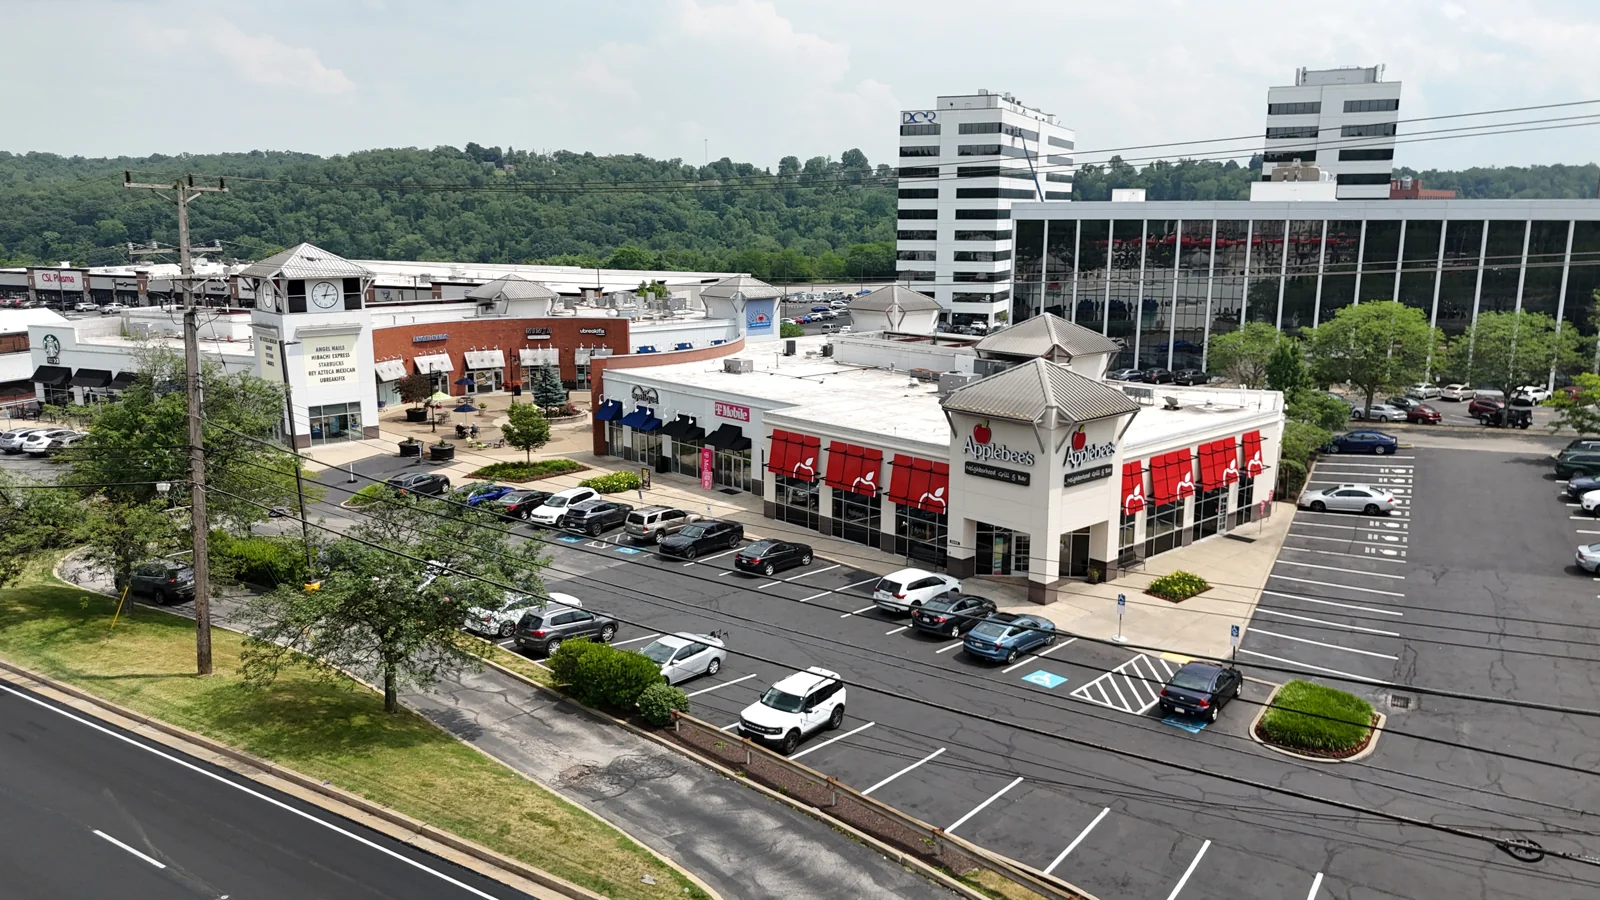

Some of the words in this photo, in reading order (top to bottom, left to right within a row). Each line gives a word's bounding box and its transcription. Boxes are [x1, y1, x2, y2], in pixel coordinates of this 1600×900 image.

[42, 273, 53, 282] CSL
[318, 360, 344, 368] STARBUCKS
[963, 435, 1035, 467] Applebee's
[1063, 442, 1117, 468] Applebee's
